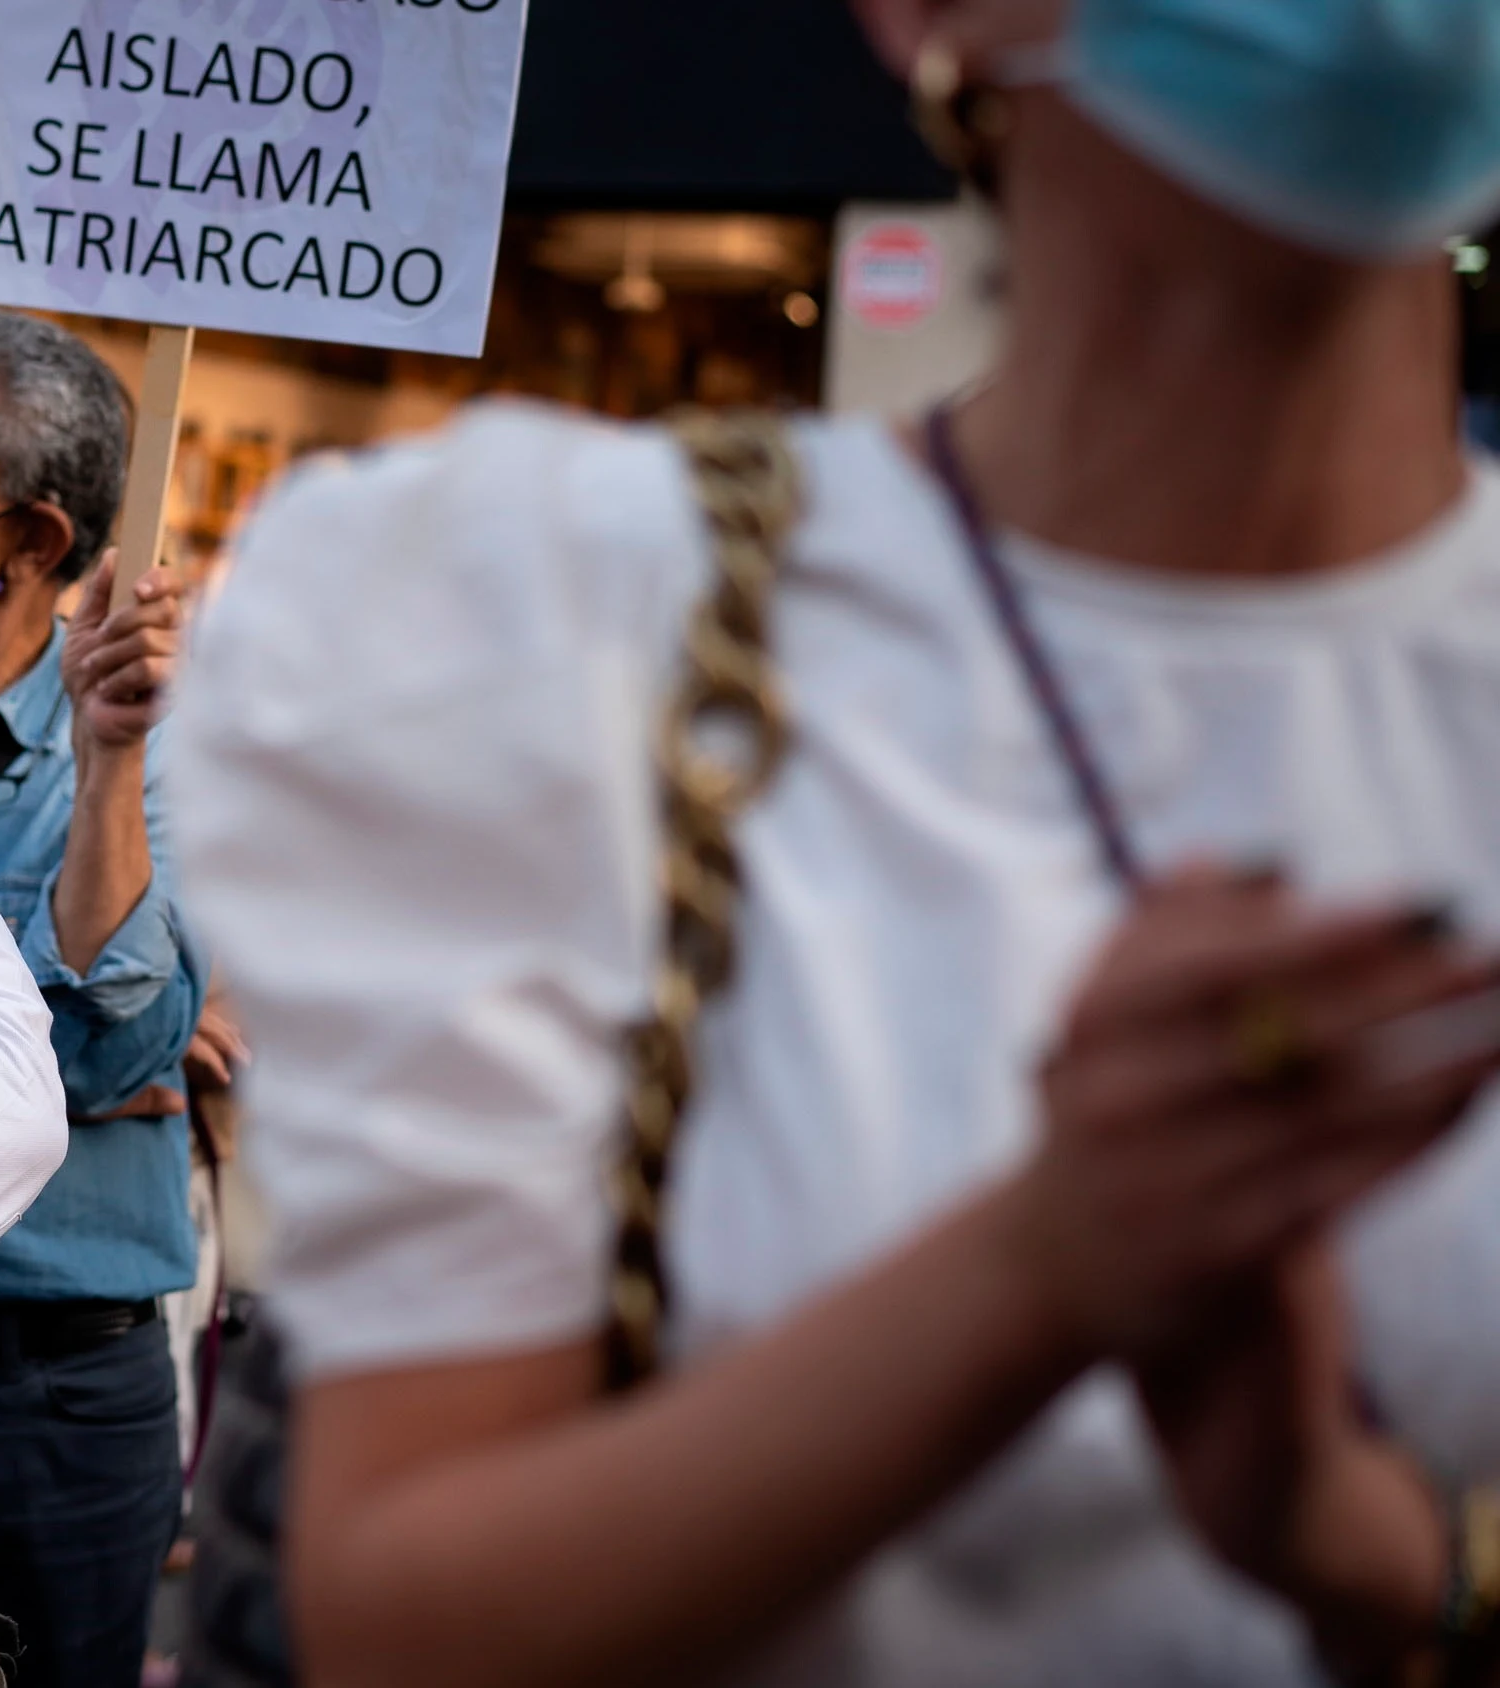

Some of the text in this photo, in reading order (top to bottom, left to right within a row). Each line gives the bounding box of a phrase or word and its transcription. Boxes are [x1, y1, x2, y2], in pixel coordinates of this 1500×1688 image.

[45, 26, 372, 129] AISLADO,
[27, 118, 372, 212] SE LLAMA
